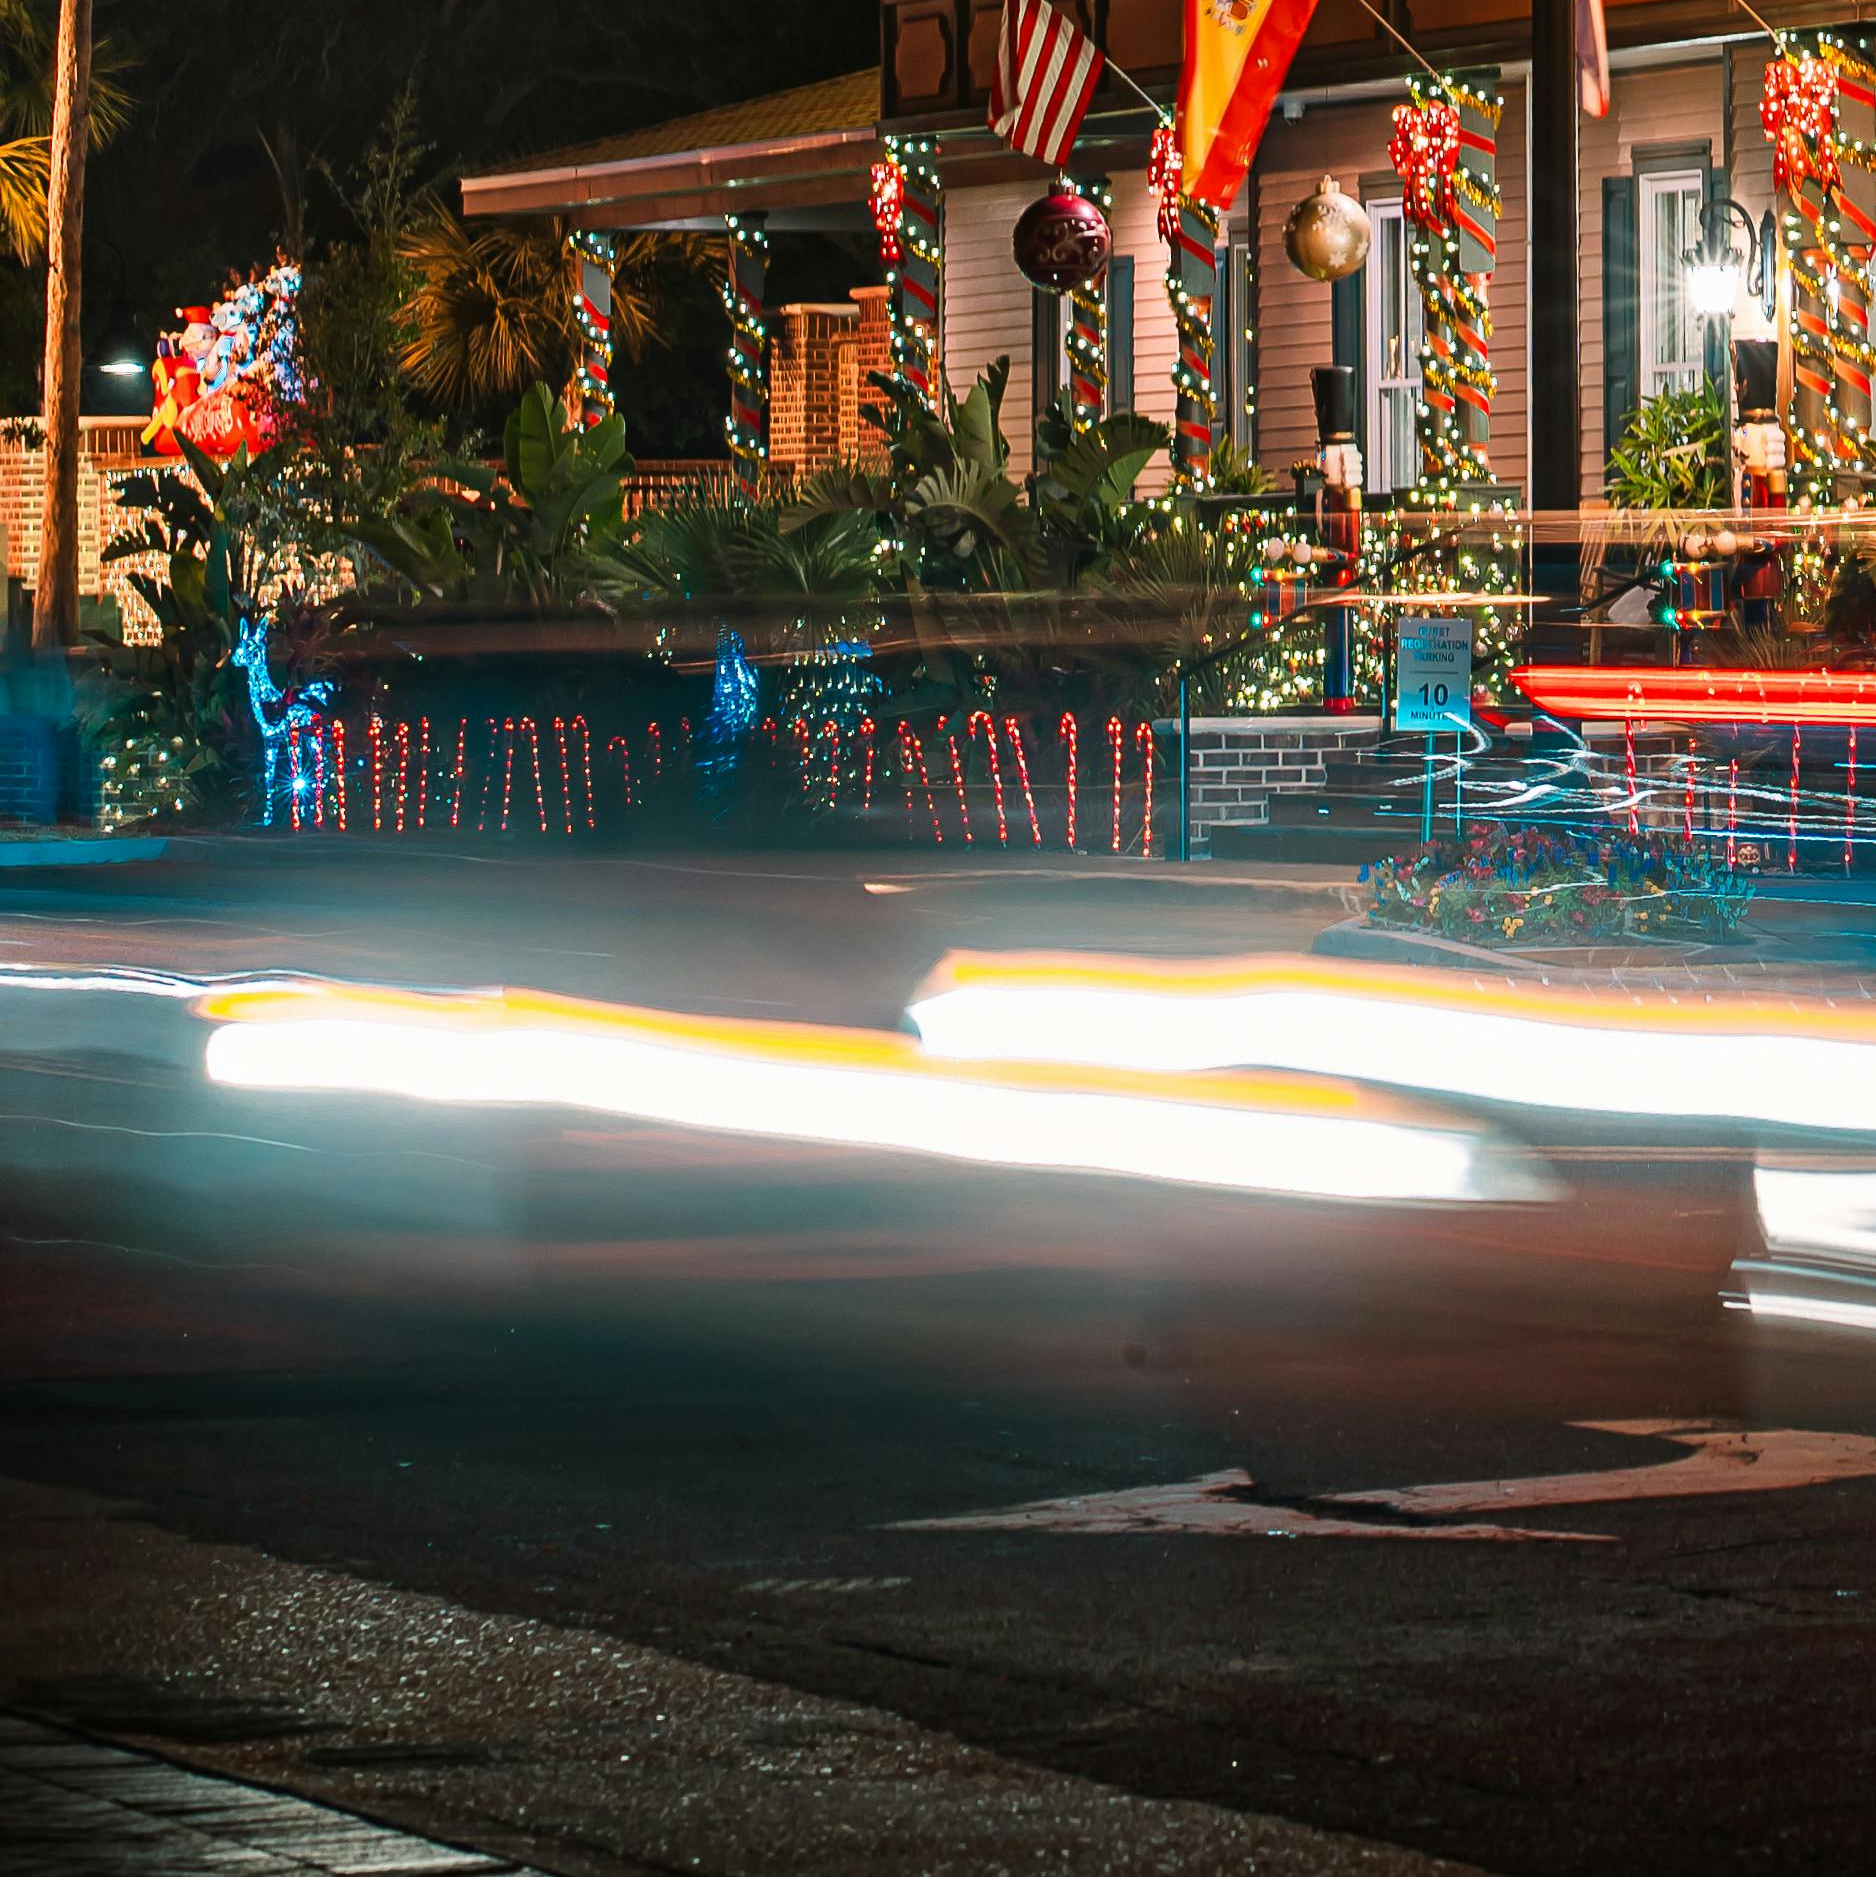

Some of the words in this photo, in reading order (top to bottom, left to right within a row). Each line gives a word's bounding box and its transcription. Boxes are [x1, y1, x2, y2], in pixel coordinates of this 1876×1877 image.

[1401, 638, 1469, 650] REGIRATION
[1414, 652, 1455, 663] ARKING
[1418, 682, 1449, 706] 10
[1410, 710, 1453, 720] MINUTE
